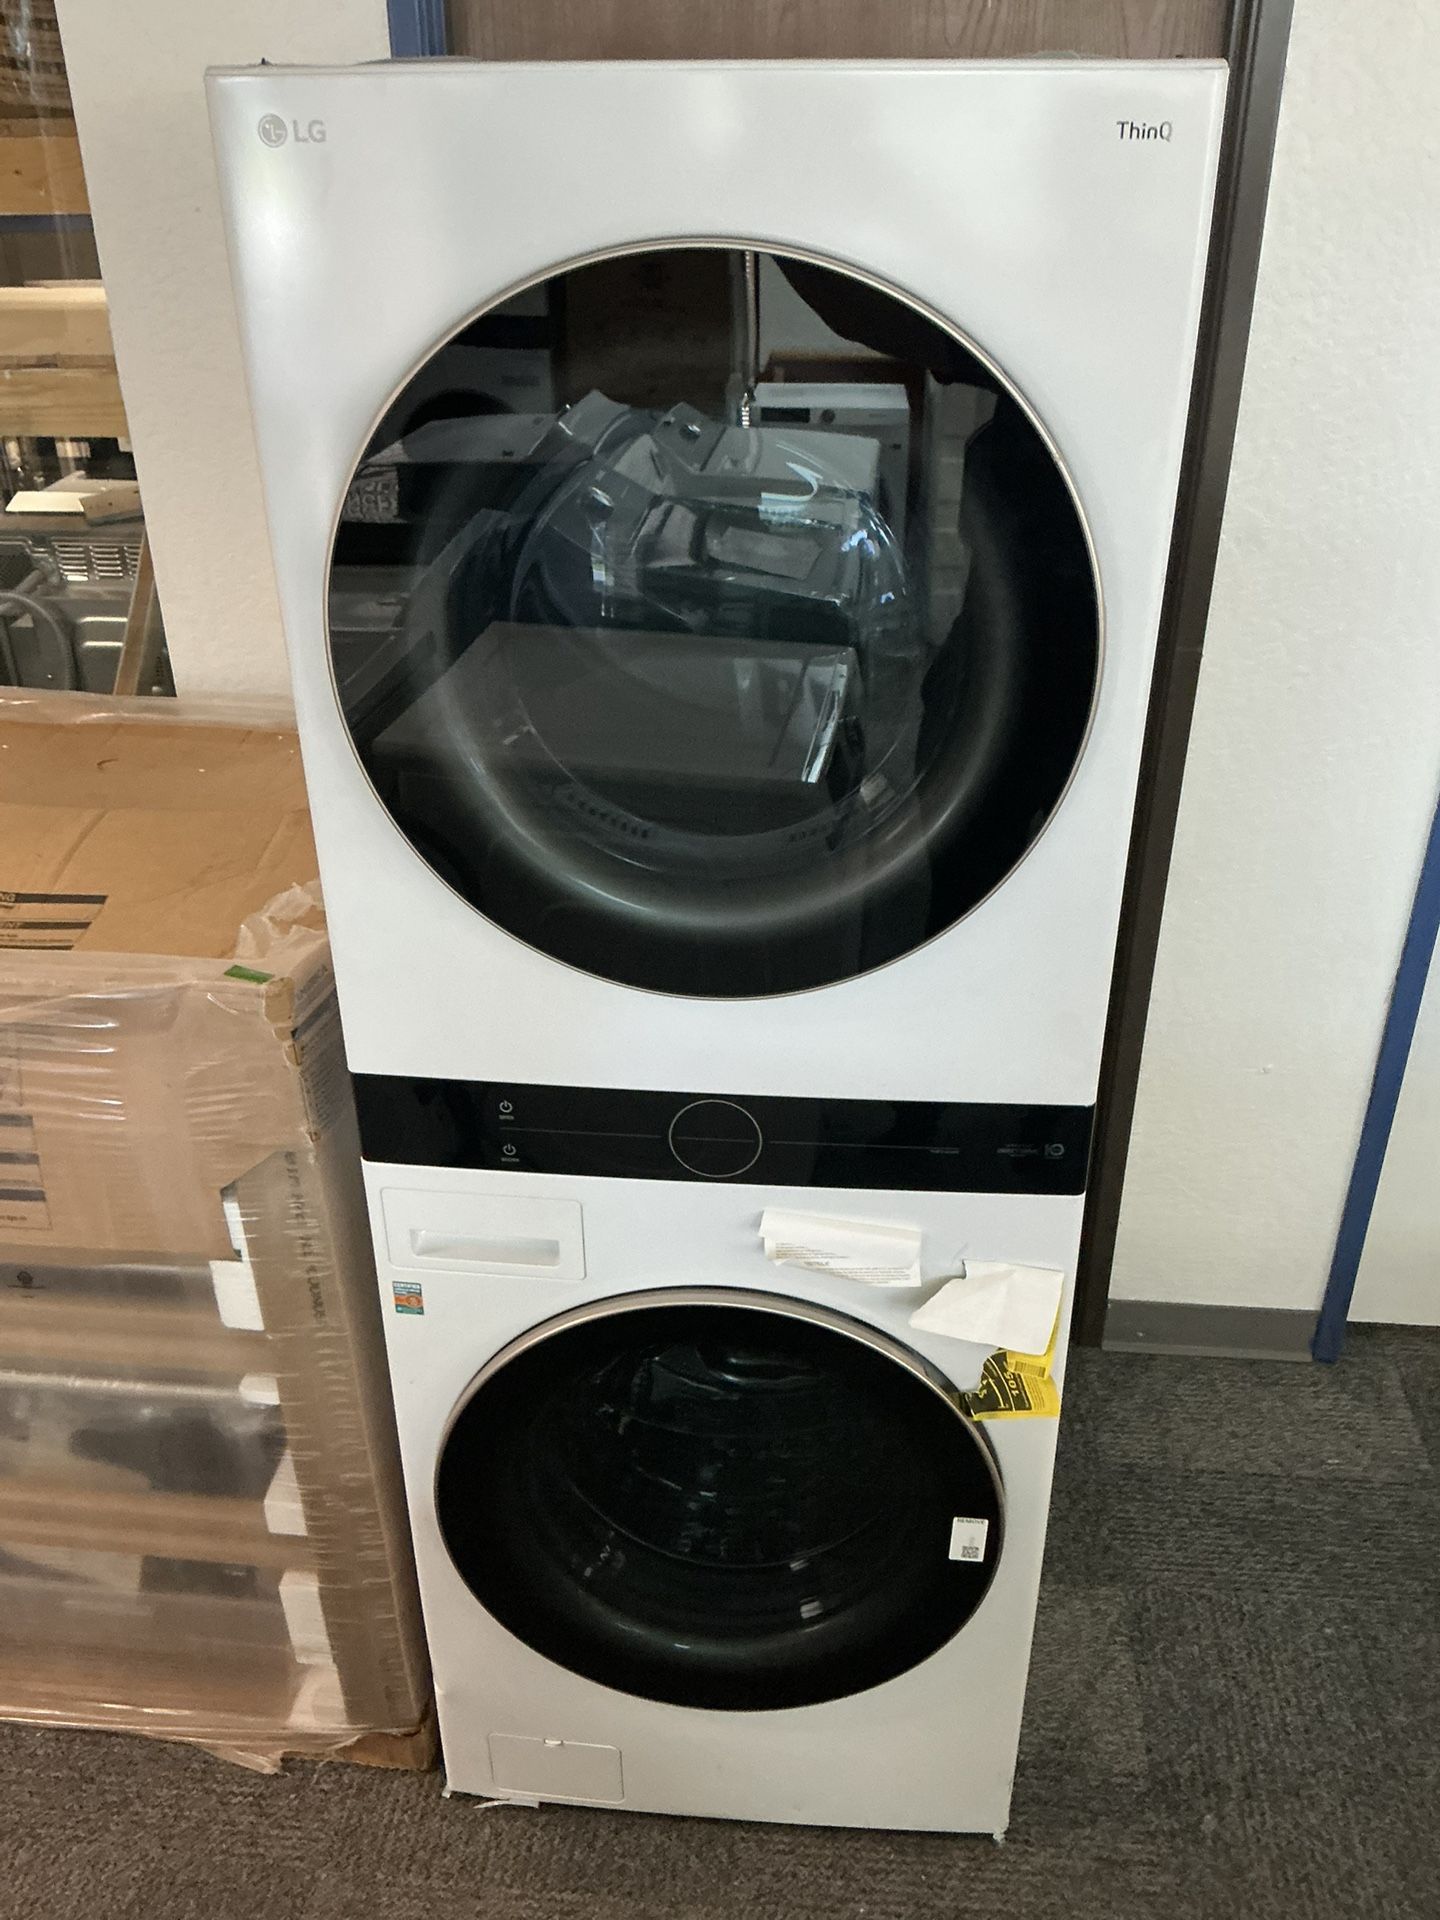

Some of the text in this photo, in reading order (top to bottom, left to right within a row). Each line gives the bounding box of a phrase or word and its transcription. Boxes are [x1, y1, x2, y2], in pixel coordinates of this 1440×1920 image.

[293, 119, 327, 144] LG
[1116, 120, 1173, 142] ThinQ
[1003, 1371, 1020, 1397] 105
